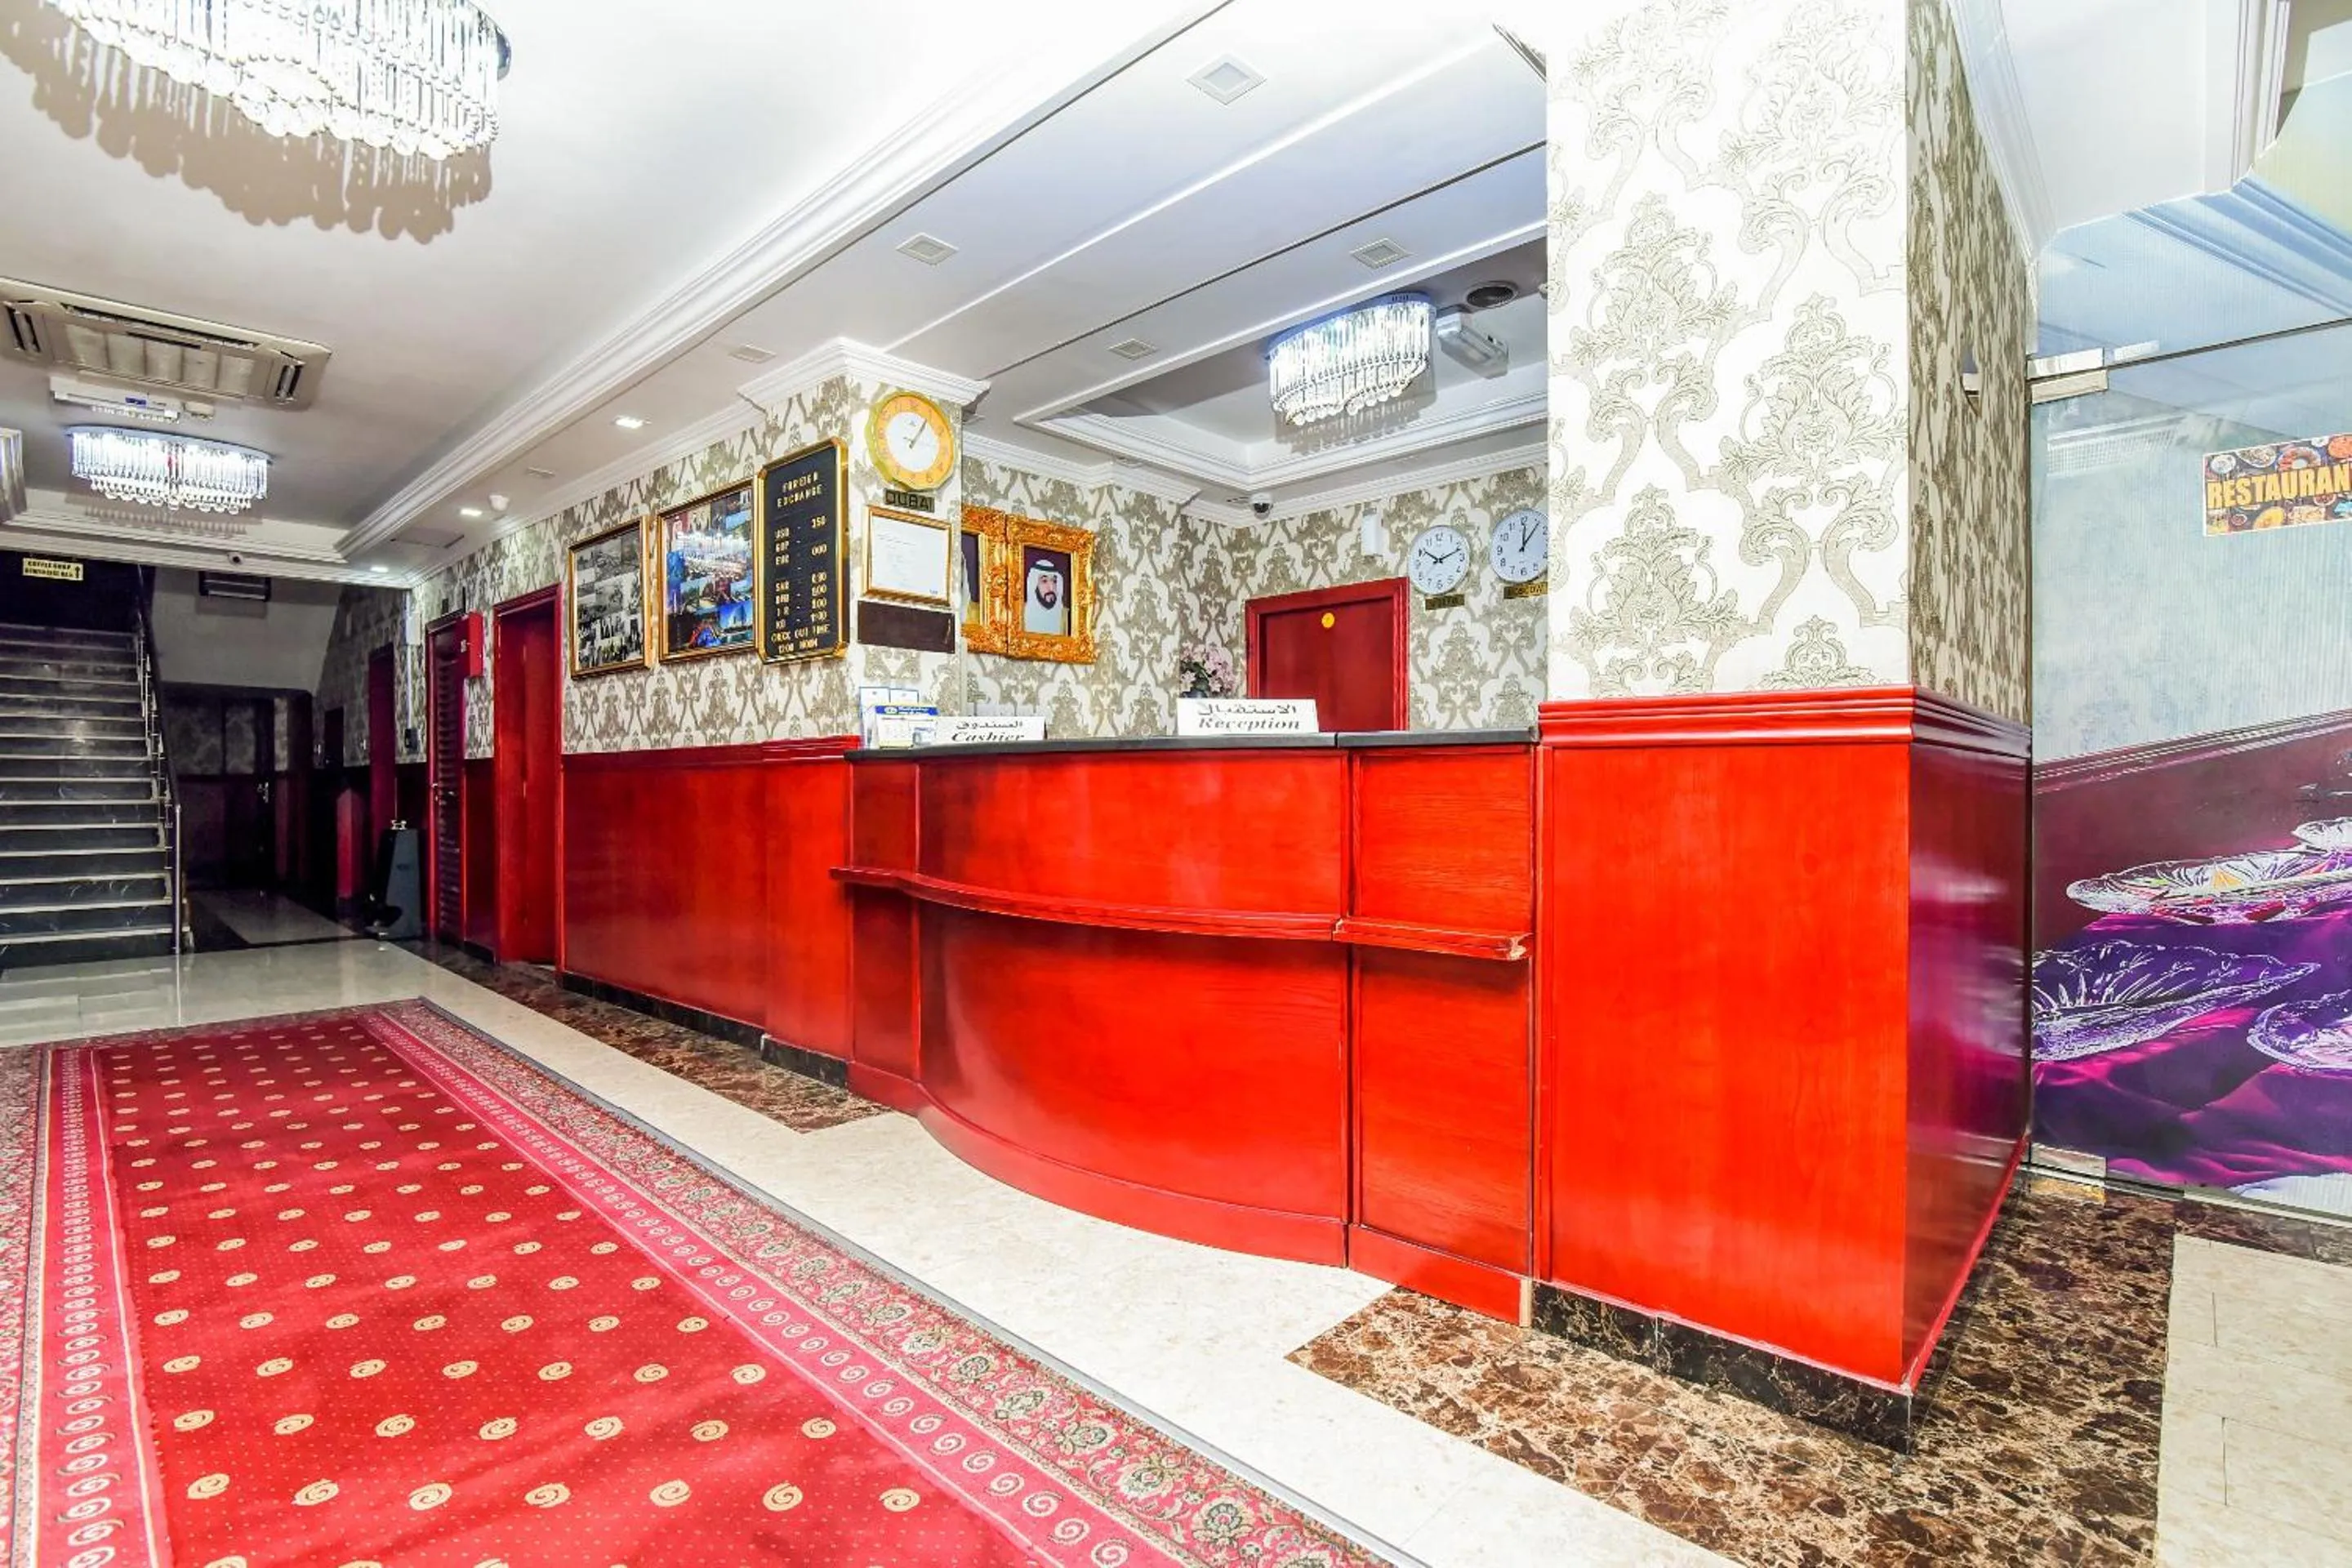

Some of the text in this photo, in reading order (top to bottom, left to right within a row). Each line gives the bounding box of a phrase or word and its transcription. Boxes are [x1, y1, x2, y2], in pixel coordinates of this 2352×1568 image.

[2207, 462, 2352, 510] RESTAURAN
[777, 484, 822, 508] EXCHANGE
[885, 489, 933, 512] DUBAI
[1197, 703, 1297, 715] الاستقبال
[1199, 717, 1300, 732] Reception
[951, 732, 1025, 742] Cashier
